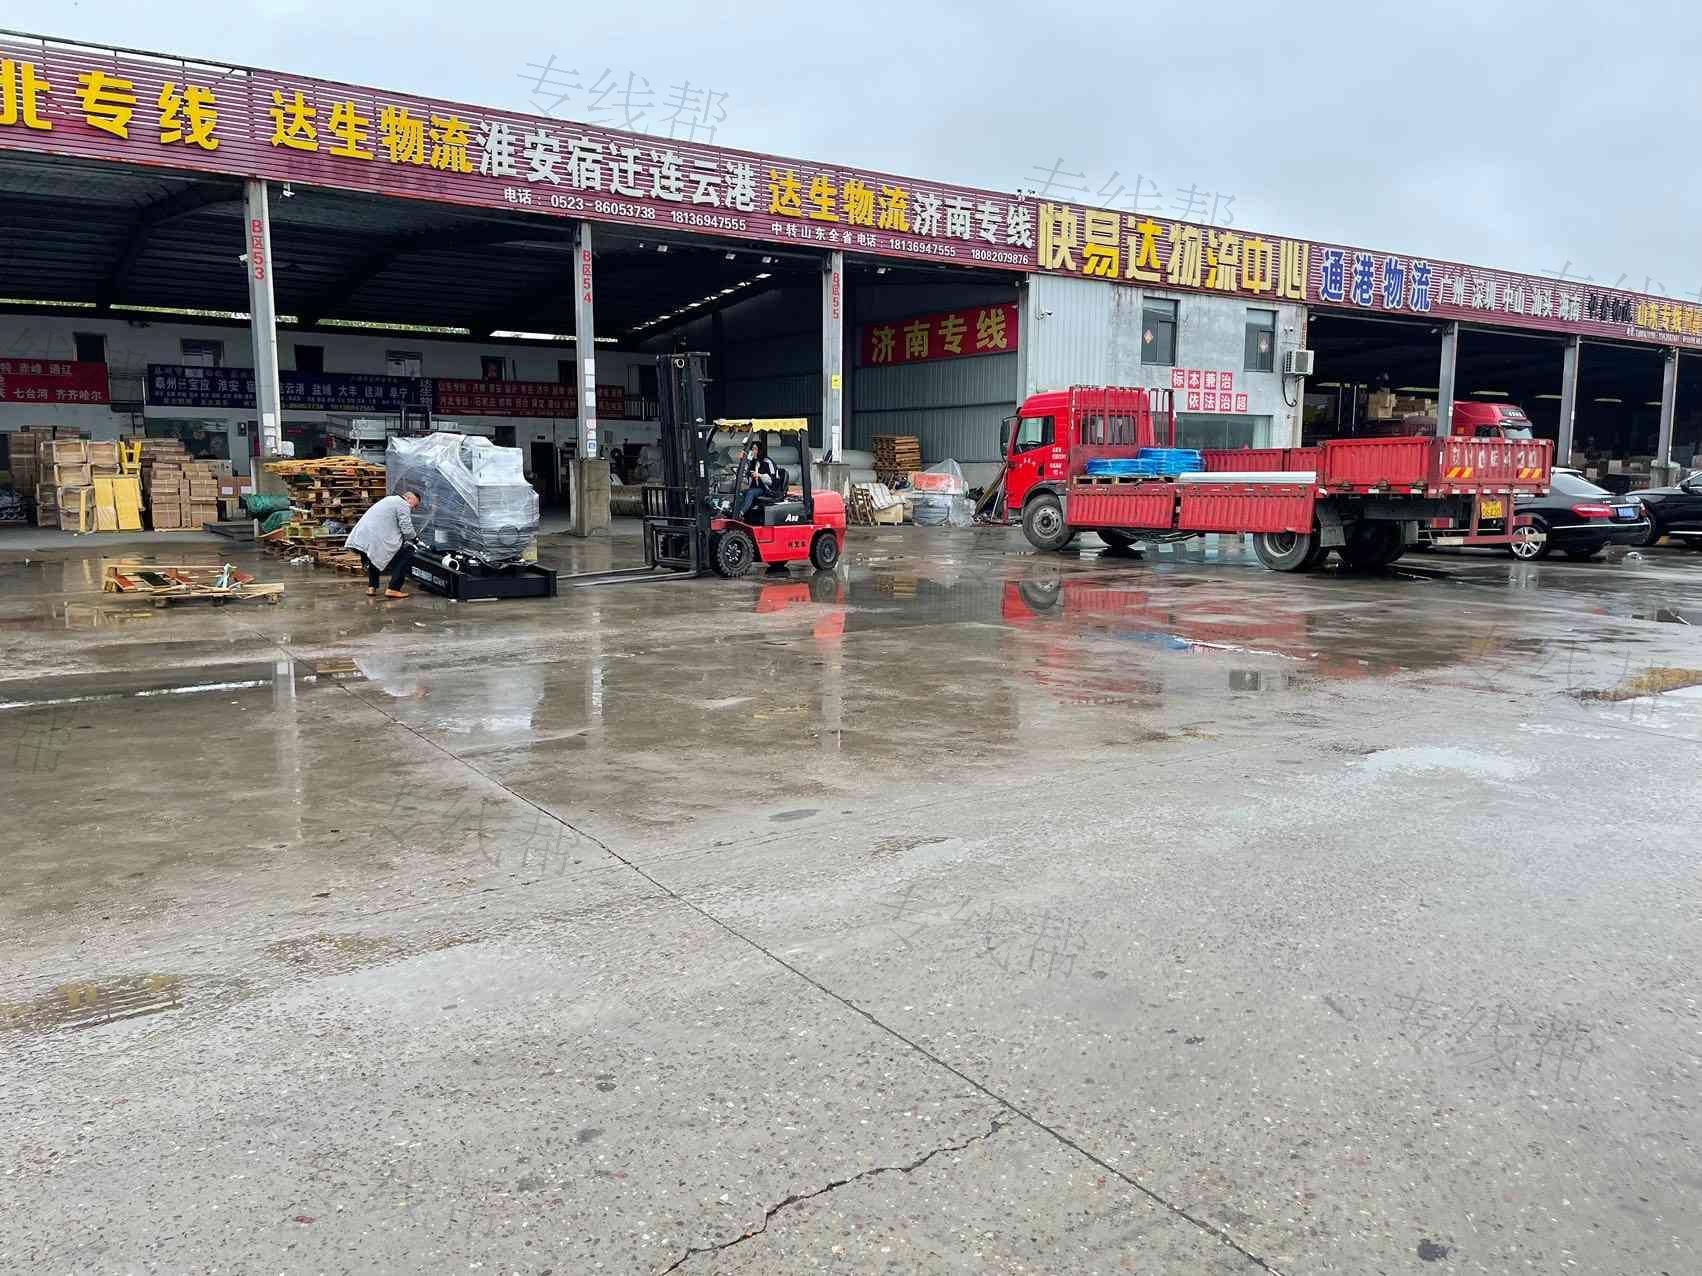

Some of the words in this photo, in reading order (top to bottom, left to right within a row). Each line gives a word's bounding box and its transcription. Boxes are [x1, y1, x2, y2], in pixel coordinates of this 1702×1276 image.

[269, 89, 472, 174] 达生物流
[475, 121, 755, 213] 淮安宿迁连云港
[670, 210, 747, 232] 18136947555
[768, 168, 911, 233] 达生物流
[912, 191, 1034, 250] 济南专线
[771, 221, 852, 246] 中转山东全省
[971, 248, 1030, 266] 18082079876
[1038, 203, 1310, 300] 快易达物流中心
[1319, 248, 1433, 313] 通港物流
[872, 307, 1008, 364] 济南专线
[12, 387, 49, 401] 七台河
[55, 388, 103, 402] 齐齐哈尔
[1173, 370, 1232, 389] 标本兼治
[1188, 391, 1248, 411] 依法治超
